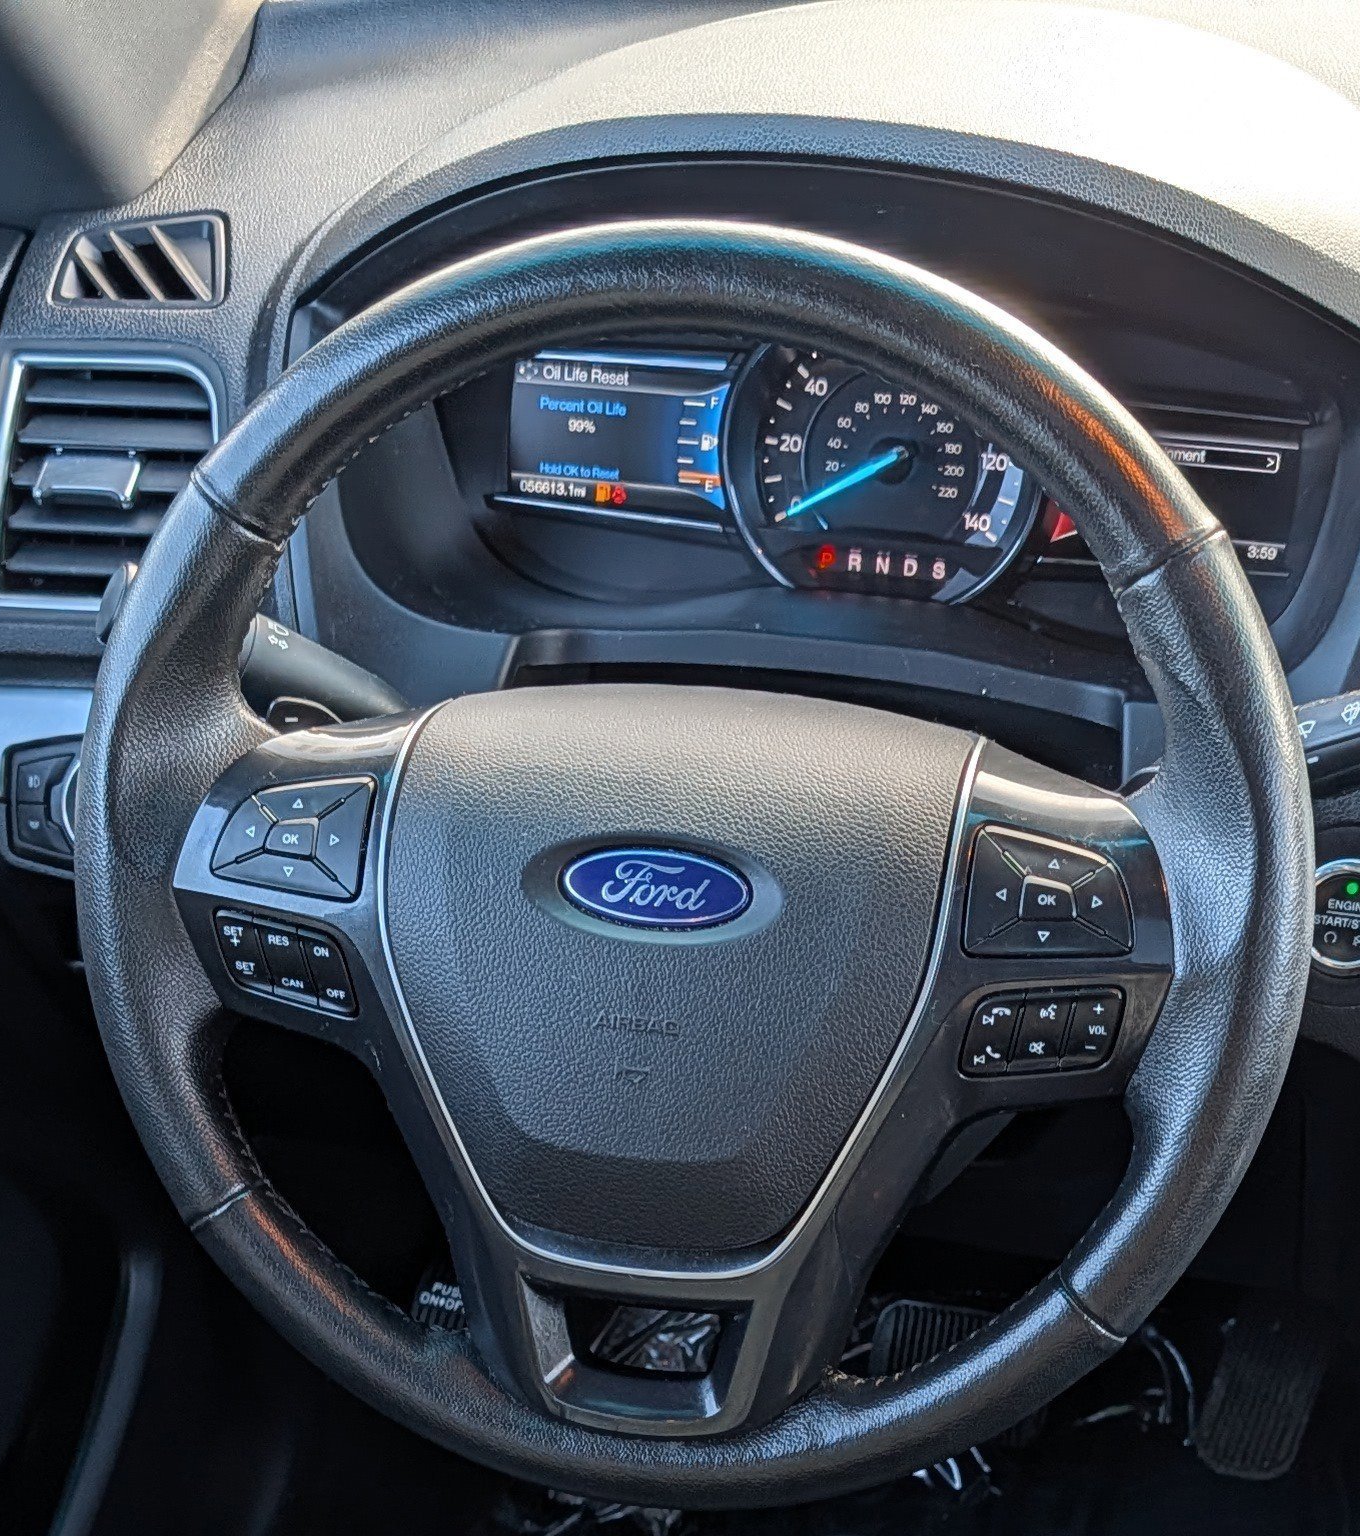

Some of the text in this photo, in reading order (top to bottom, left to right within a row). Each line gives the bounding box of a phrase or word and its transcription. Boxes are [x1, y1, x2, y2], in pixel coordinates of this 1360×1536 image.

[542, 365, 630, 386] Oil Life Reset
[803, 379, 829, 397] 40
[710, 397, 719, 410] F
[873, 393, 891, 405] 100
[899, 393, 917, 406] 120
[540, 397, 627, 418] Percent Oil Life
[854, 402, 870, 414] 80
[921, 402, 939, 416] 140
[568, 419, 596, 434] 99%
[837, 417, 852, 429] 60
[936, 422, 954, 434] 160
[779, 435, 803, 453] 20
[826, 437, 841, 449] 40
[944, 442, 963, 455] 180
[825, 460, 839, 472] 20
[981, 453, 1008, 472] 120
[540, 462, 620, 481] Hold OK to Reset
[943, 466, 965, 478] 200
[704, 481, 713, 493] E
[937, 486, 958, 498] 220
[963, 513, 991, 532] 140
[819, 551, 833, 567] P
[1246, 546, 1279, 560] 3:59
[847, 555, 862, 572] R
[875, 558, 890, 575] N
[903, 559, 918, 577] D
[932, 561, 946, 580] S
[281, 833, 300, 846] OK
[601, 859, 711, 911] Ford
[1037, 893, 1058, 906] OK
[223, 925, 244, 938] SET
[267, 934, 290, 947] RES
[313, 946, 330, 958] ON
[235, 960, 256, 973] SET
[281, 976, 304, 989] CAN
[326, 987, 346, 1000] OFF
[1089, 1025, 1108, 1036] VOL
[431, 1282, 462, 1299] PUS
